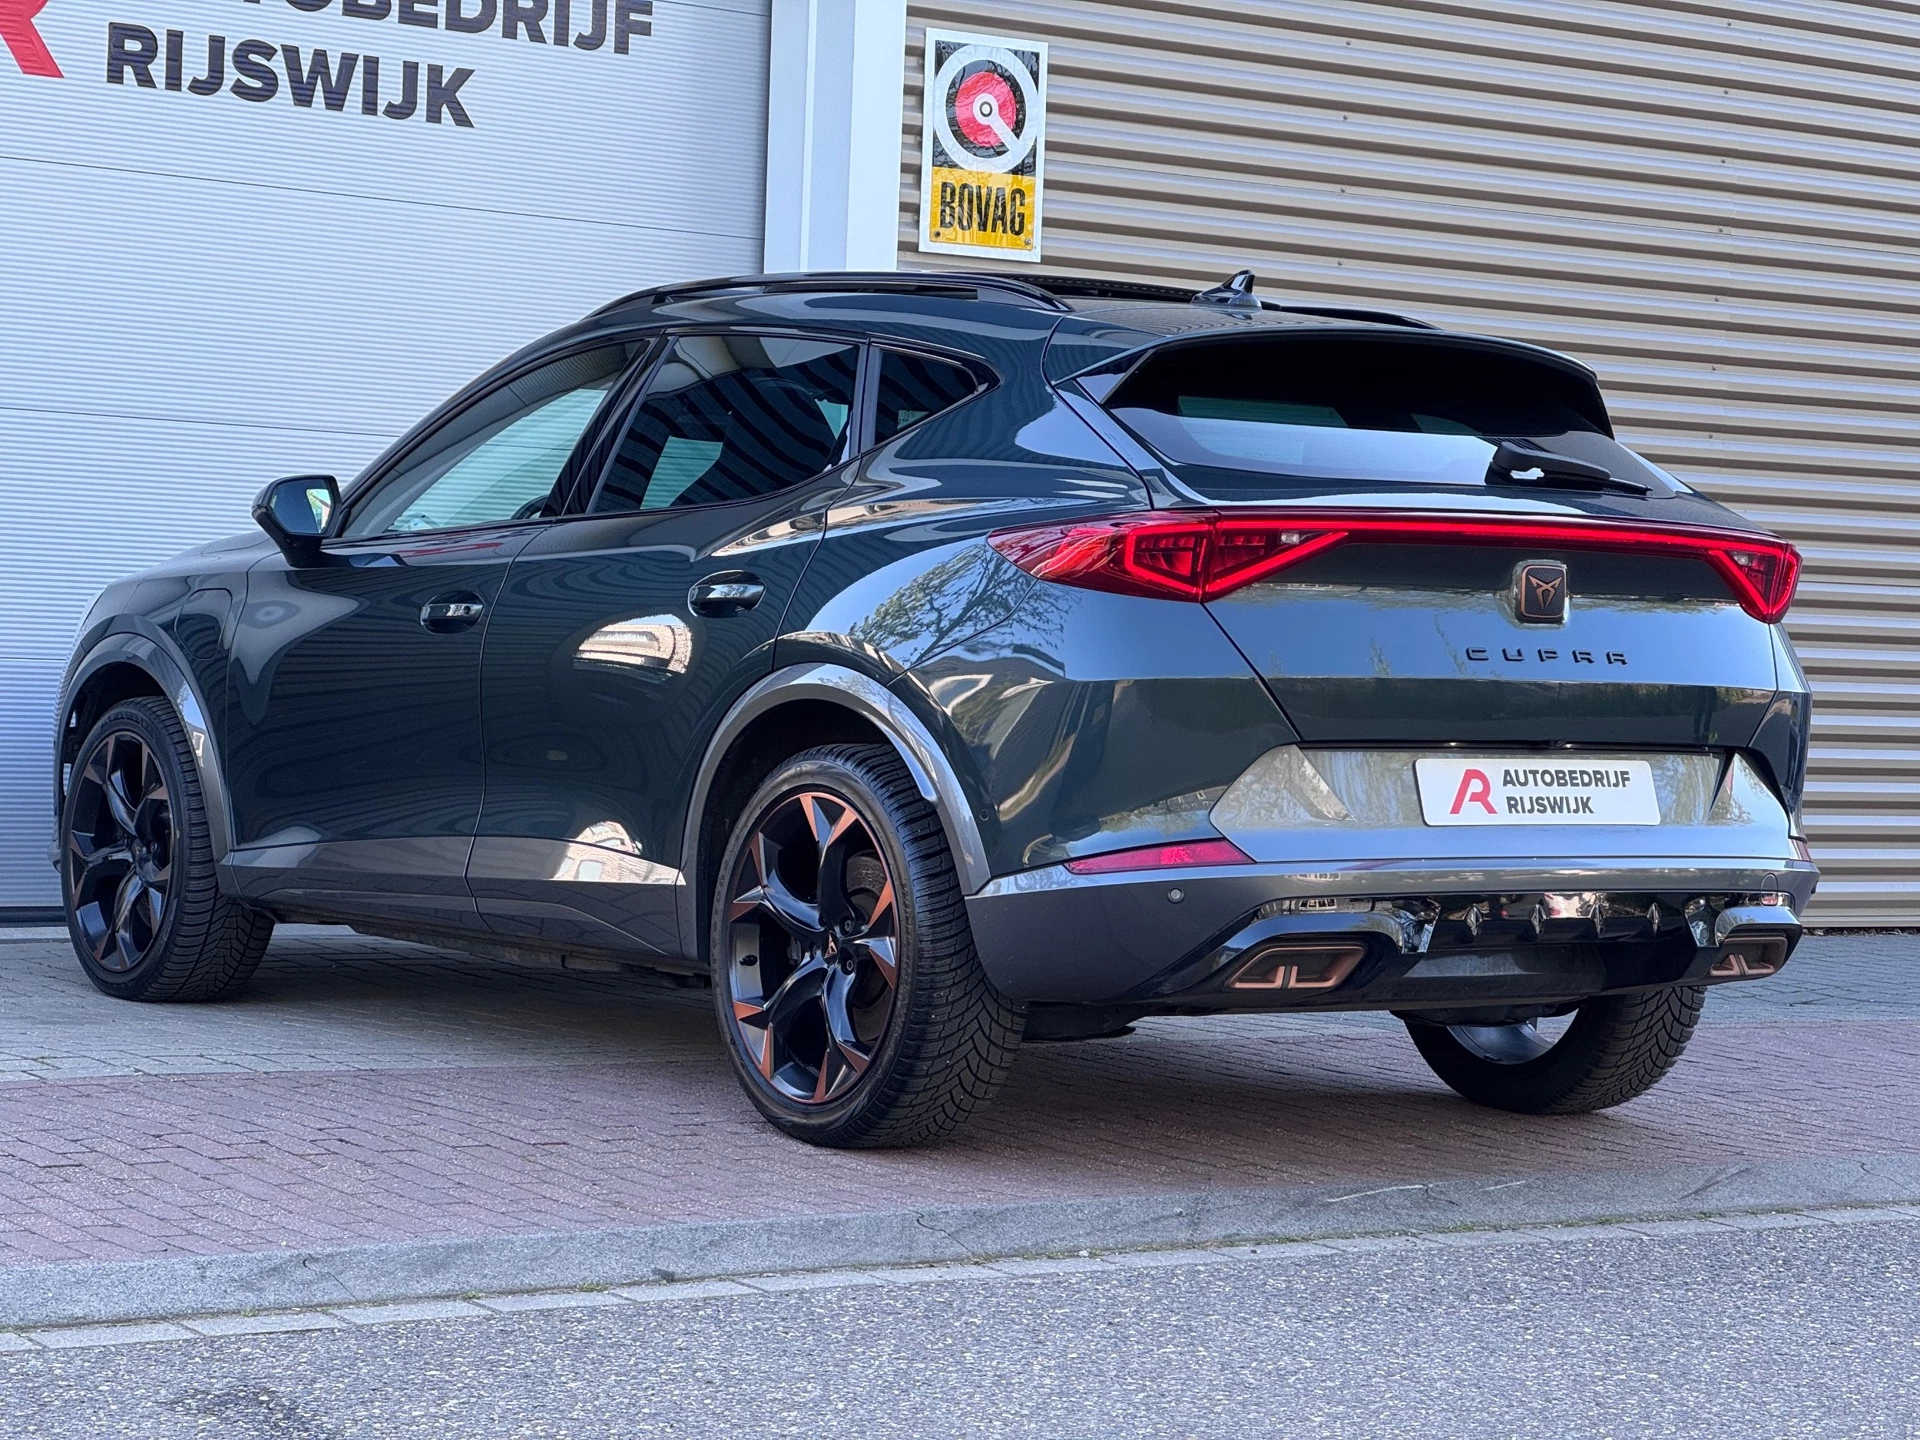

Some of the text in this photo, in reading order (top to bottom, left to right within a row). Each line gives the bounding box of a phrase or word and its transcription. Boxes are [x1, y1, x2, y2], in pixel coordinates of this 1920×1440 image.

[105, 21, 475, 128] RIJSWIJK
[939, 181, 1025, 237] BOVAG
[1466, 646, 1628, 665] CUPRA
[1502, 769, 1631, 788] AUTOBEDRIJF
[1506, 796, 1594, 815] RIJSWIJK
